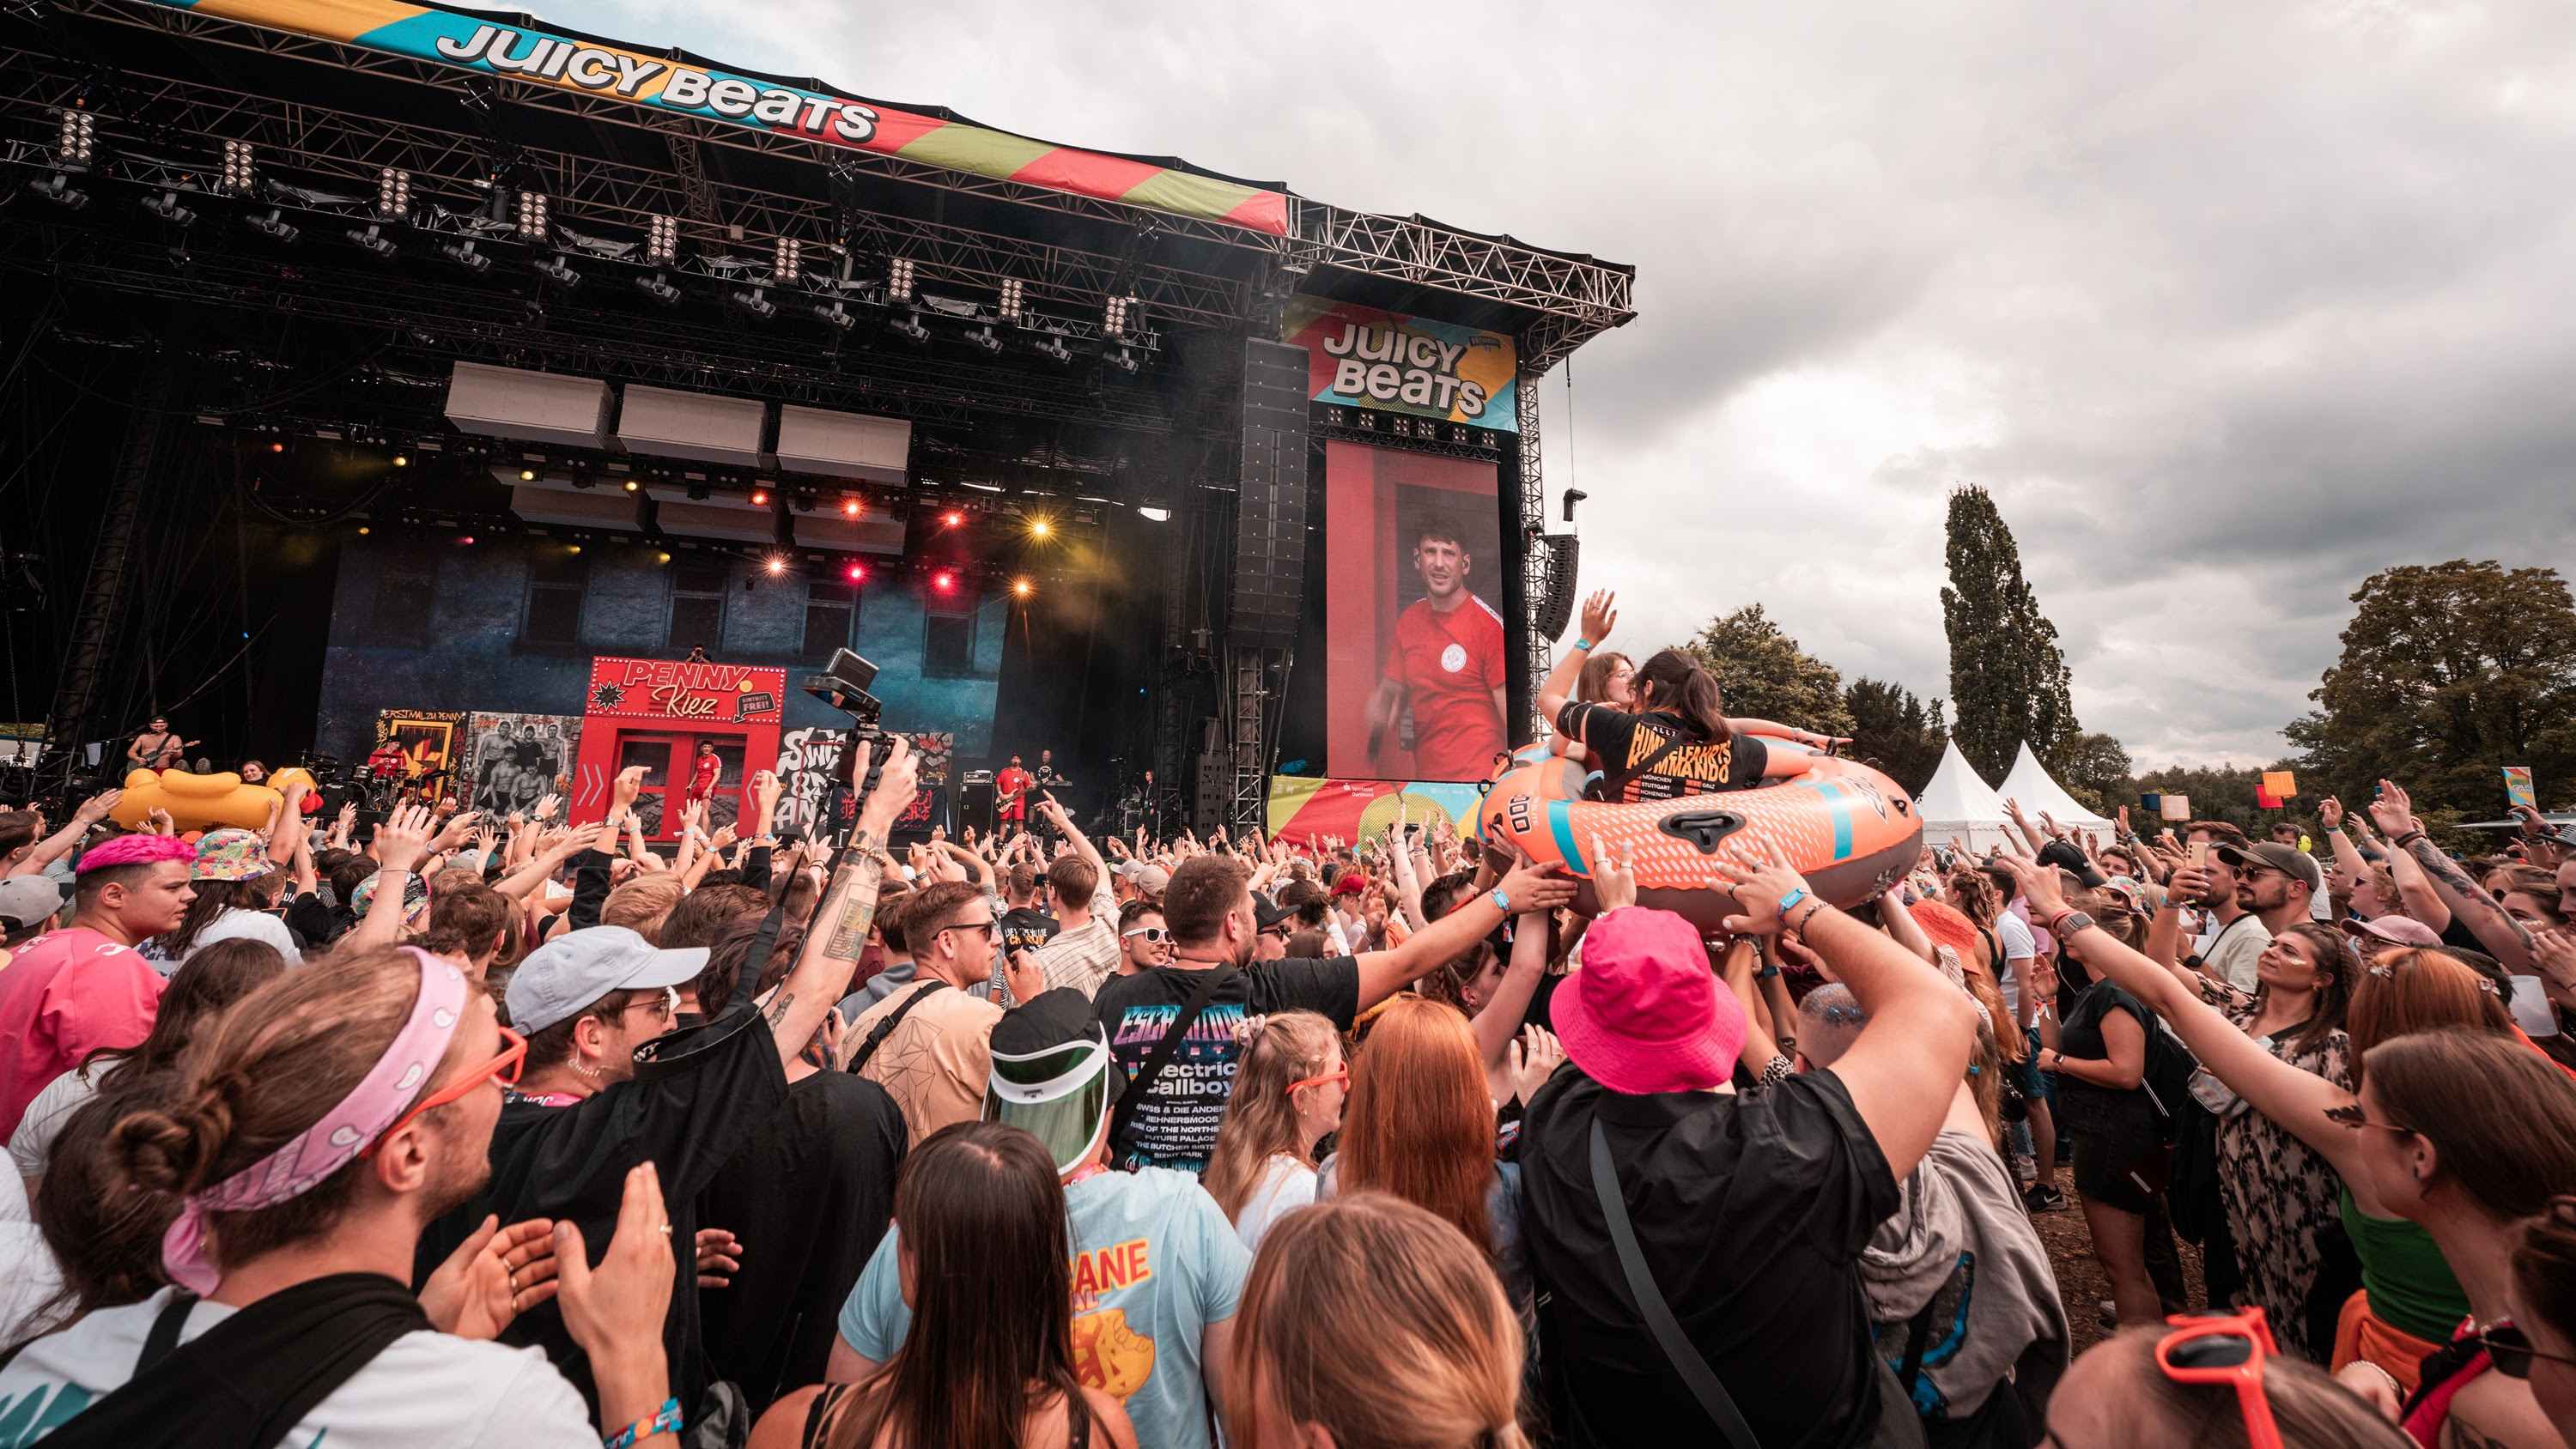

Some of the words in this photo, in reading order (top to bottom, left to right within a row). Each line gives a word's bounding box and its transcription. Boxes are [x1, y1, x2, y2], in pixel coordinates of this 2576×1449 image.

[652, 685, 718, 717] Kiez
[743, 700, 770, 712] FREI!
[1626, 747, 1729, 784] KMMANDO
[1641, 782, 1670, 791] STUTTGART
[1157, 1061, 1237, 1078] ectric
[1192, 1105, 1229, 1113] ANDER
